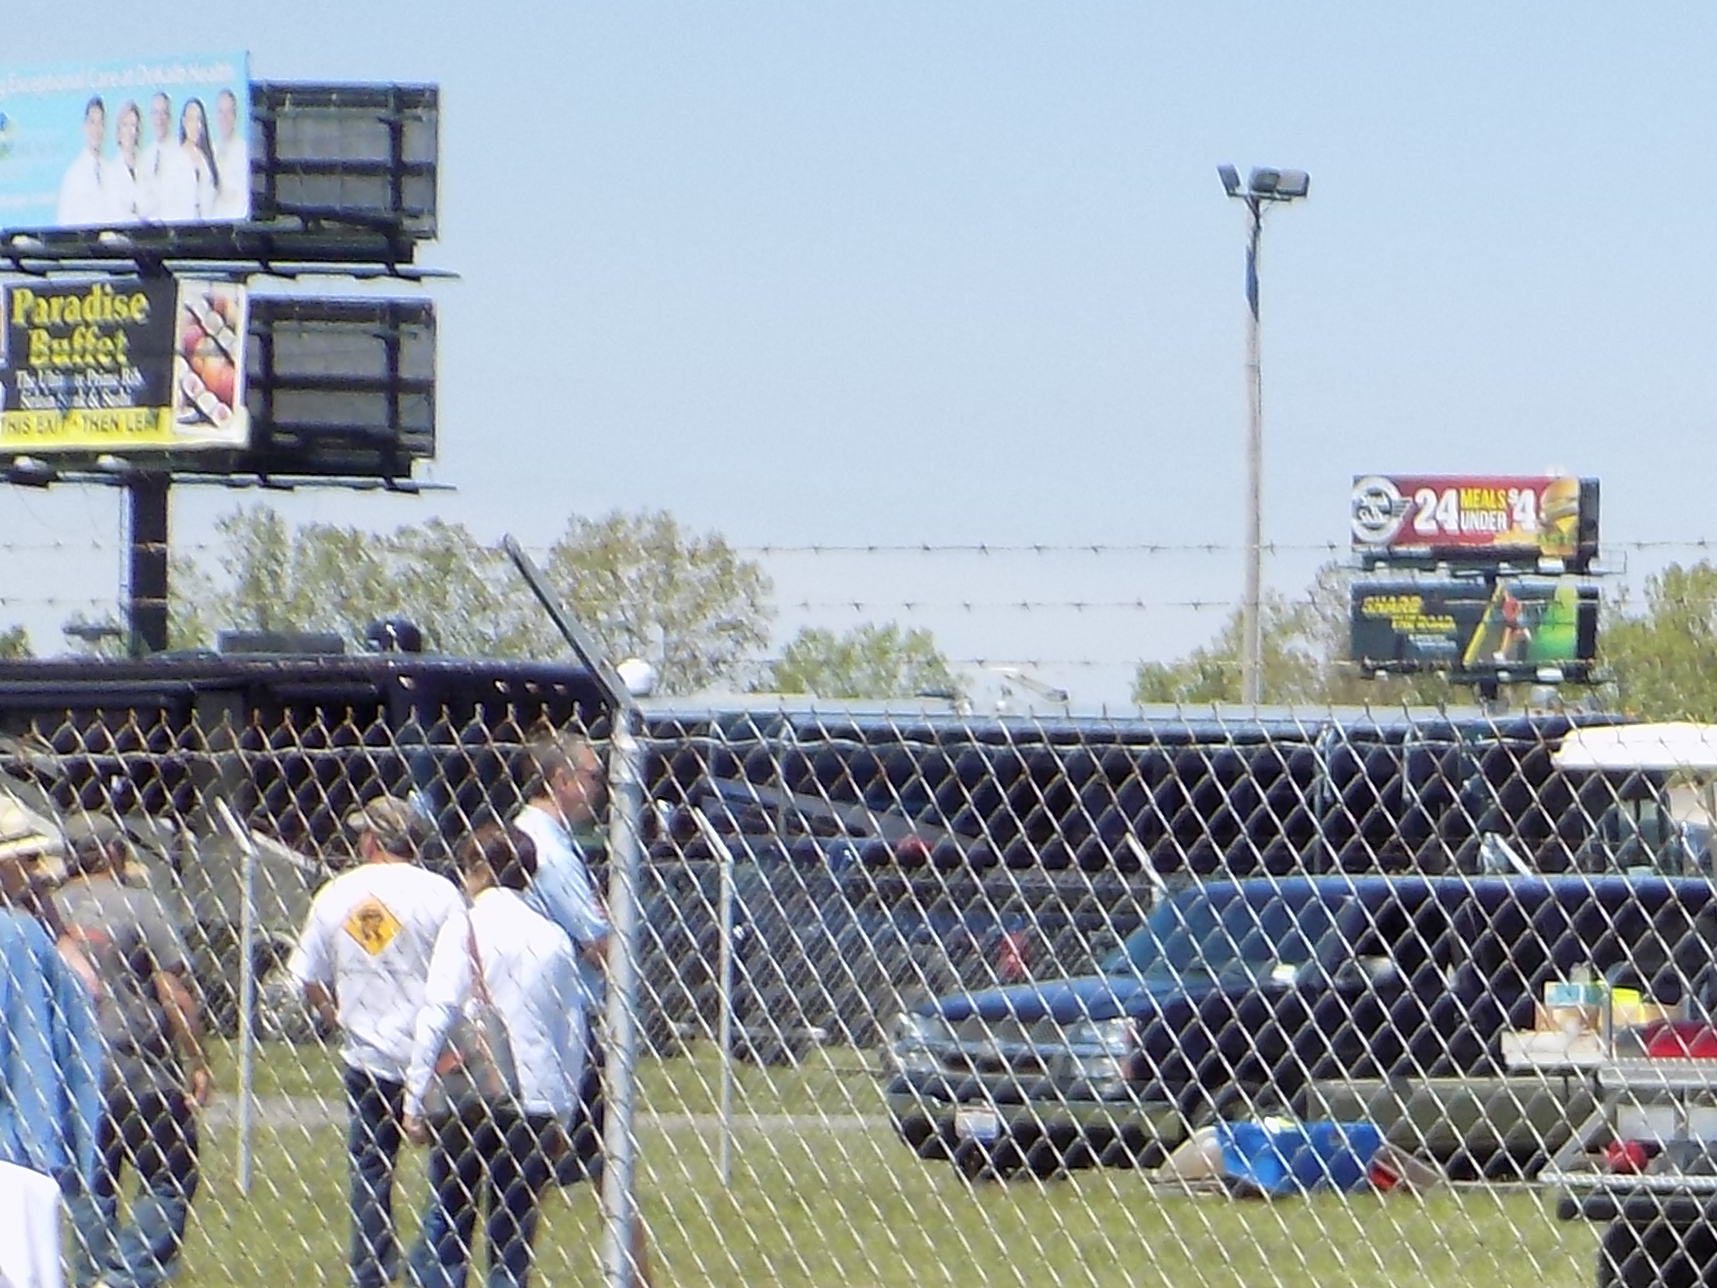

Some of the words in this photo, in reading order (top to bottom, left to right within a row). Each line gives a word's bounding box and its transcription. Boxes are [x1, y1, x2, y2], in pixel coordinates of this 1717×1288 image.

[11, 282, 150, 326] Paradise
[28, 326, 131, 367] Buffet
[1413, 487, 1460, 534] 24
[1460, 487, 1508, 510] MEALS
[1508, 486, 1537, 532] $4
[1460, 510, 1508, 531] UNDER
